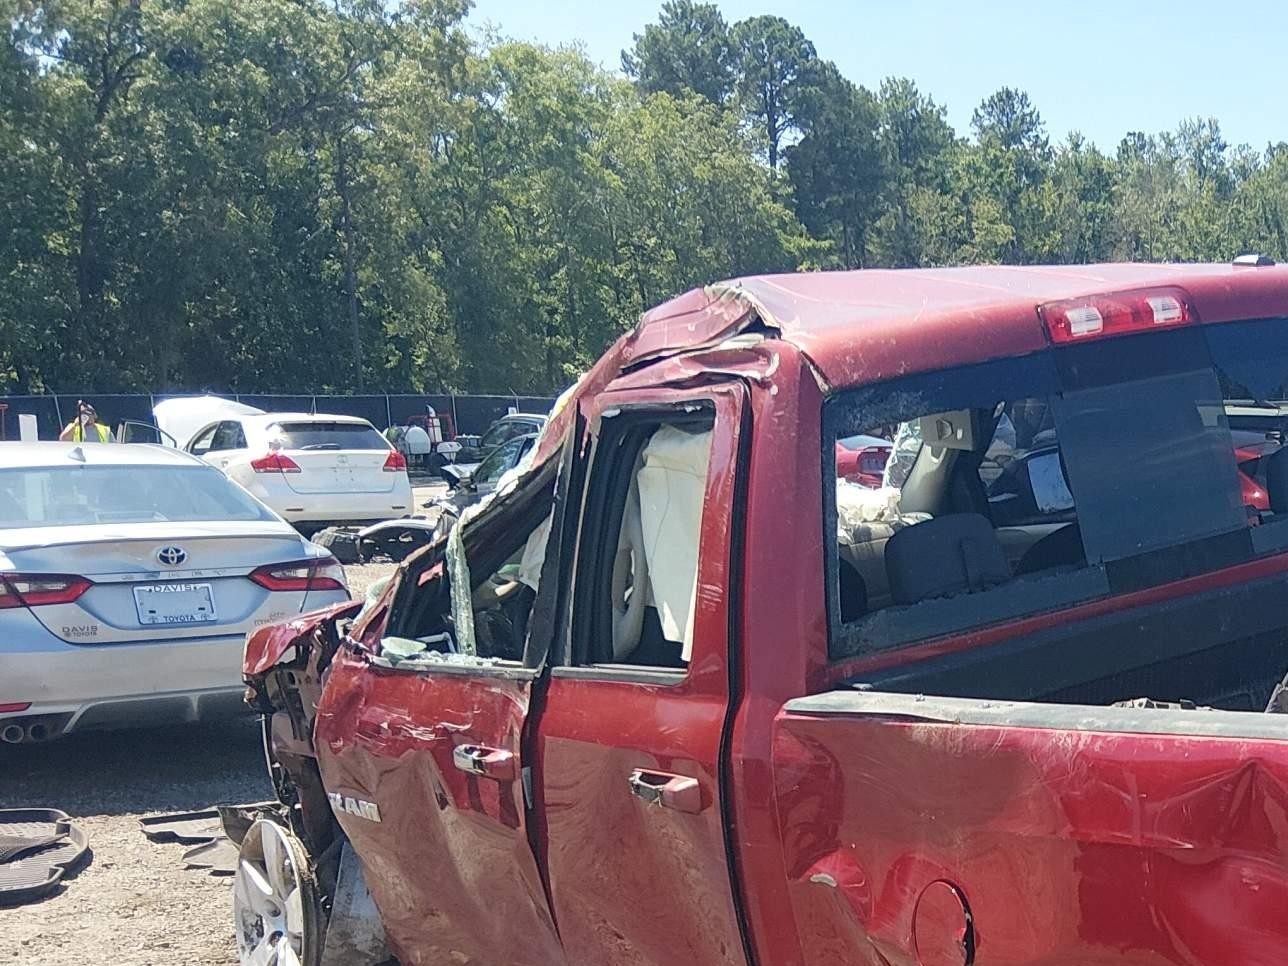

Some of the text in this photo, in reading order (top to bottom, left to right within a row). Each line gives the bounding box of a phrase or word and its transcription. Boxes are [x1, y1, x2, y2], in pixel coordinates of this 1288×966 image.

[163, 614, 197, 624] TOYOTA
[62, 625, 98, 633] DAVIS
[327, 792, 382, 823] RAM
